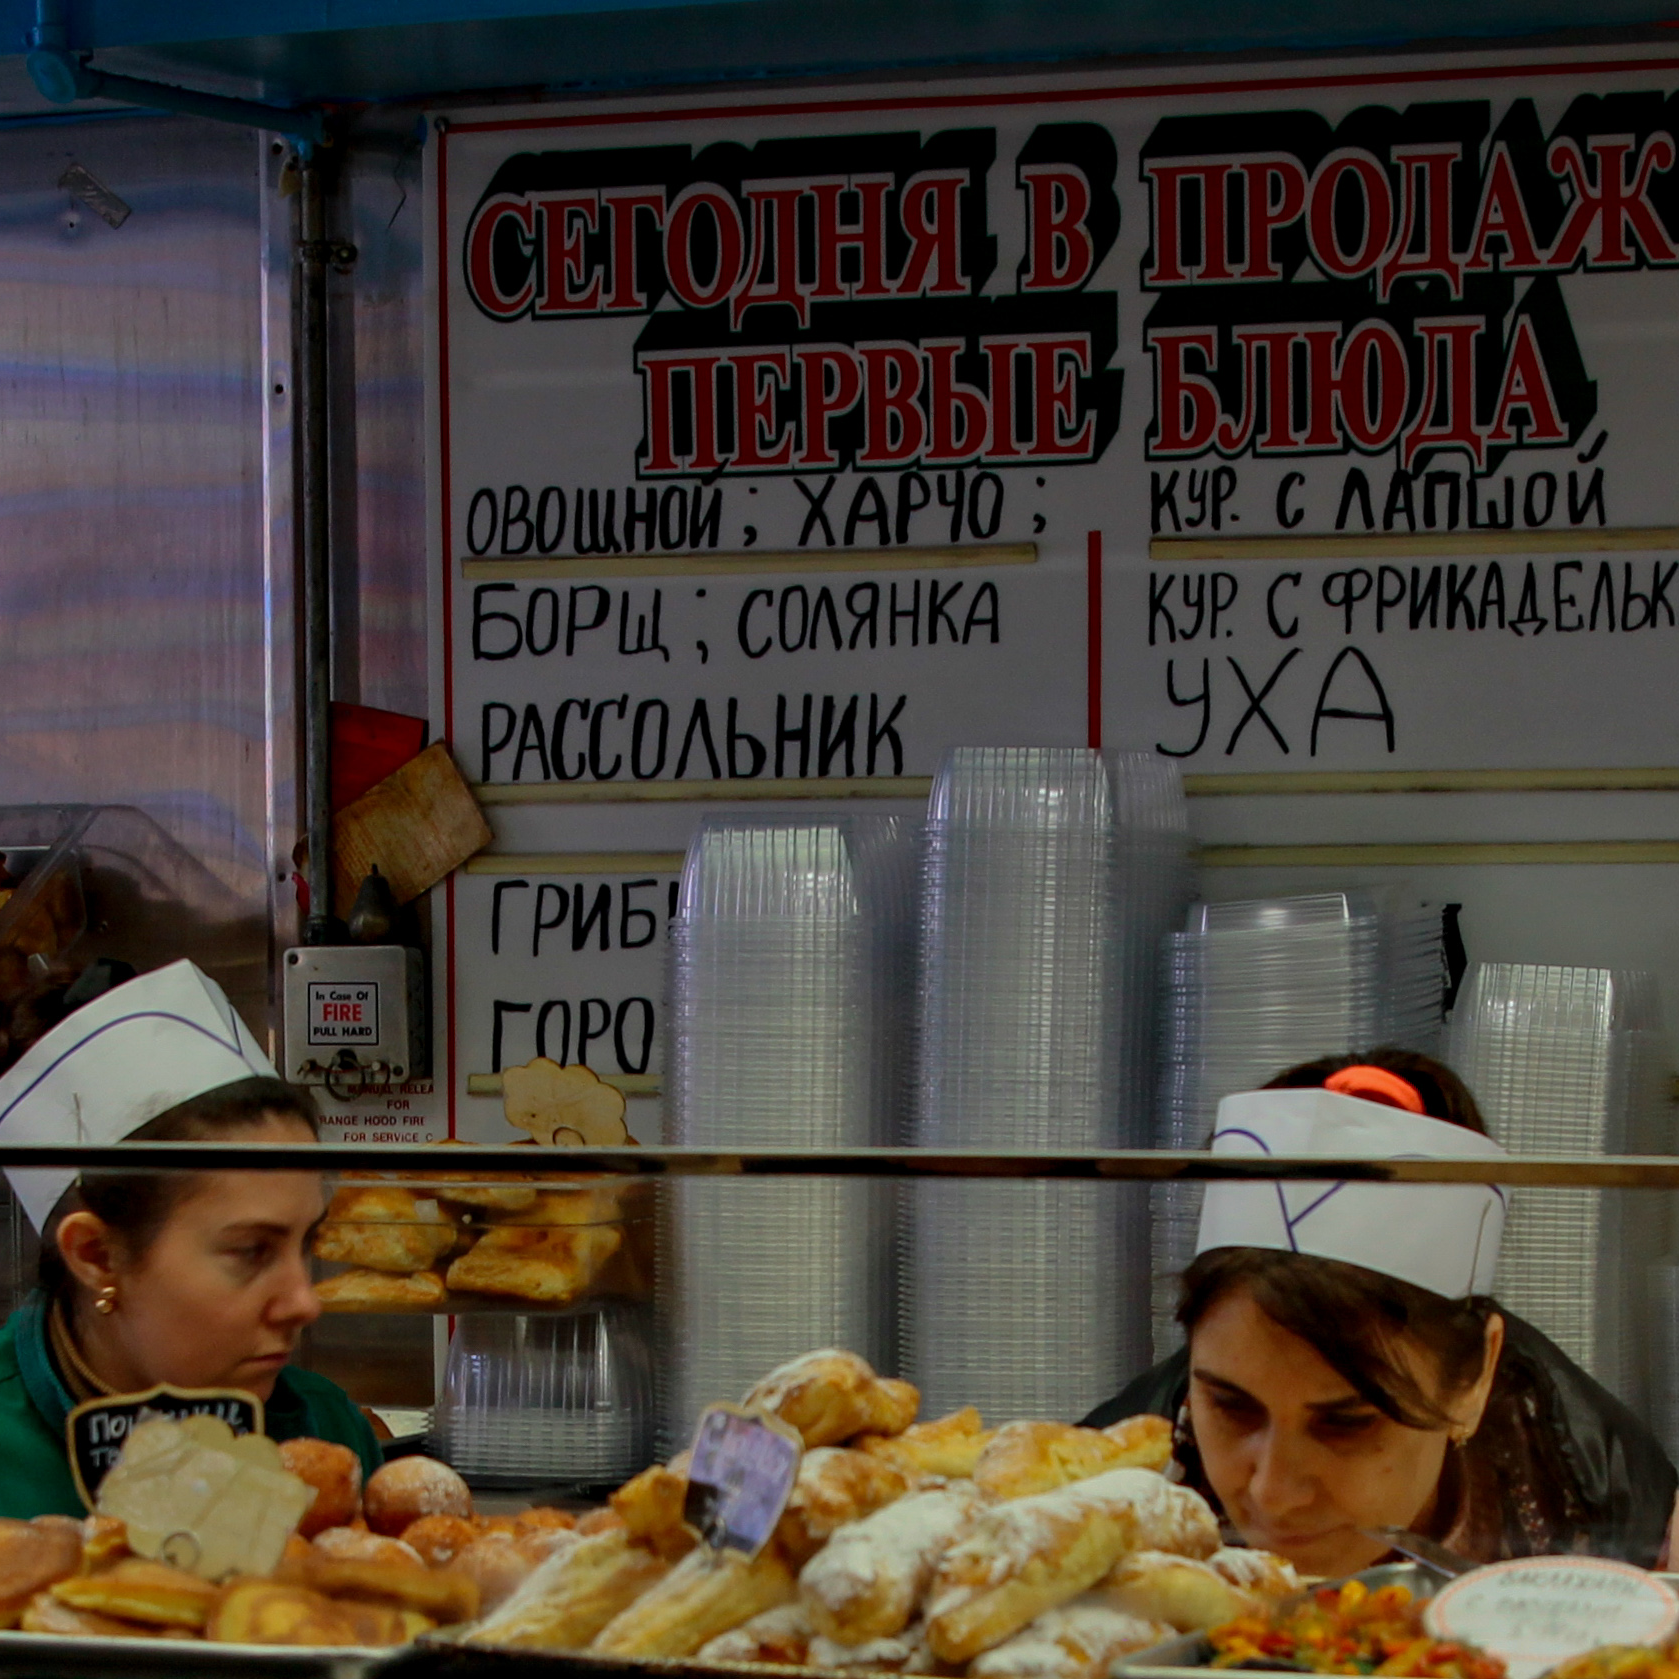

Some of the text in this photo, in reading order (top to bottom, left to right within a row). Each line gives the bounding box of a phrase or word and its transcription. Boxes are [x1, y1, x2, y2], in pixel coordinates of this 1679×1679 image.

[464, 150, 979, 333] СЕГОДНЯ
[1019, 150, 1105, 295] В
[636, 305, 1577, 478] ПЕРВЫЕ БЛЮДА
[1148, 431, 1609, 533] КУР. С ЛАПШОЙ
[737, 579, 1000, 658] СОЛЯНКА
[1148, 570, 1239, 646] КУР.
[1267, 571, 1303, 638] С
[481, 693, 908, 782] РАССОЛЬНИК
[1155, 646, 1396, 758] УХА
[492, 878, 680, 957] ГРИБ
[313, 1026, 372, 1037] PULL HARD
[315, 990, 369, 1000] In Case Of
[322, 1003, 362, 1022] FIRE
[492, 996, 655, 1075] ГОРО
[344, 1132, 366, 1142] FOR
[372, 1132, 419, 1142] SERVICE
[364, 1115, 397, 1126] HOOD
[387, 1100, 410, 1110] FOR
